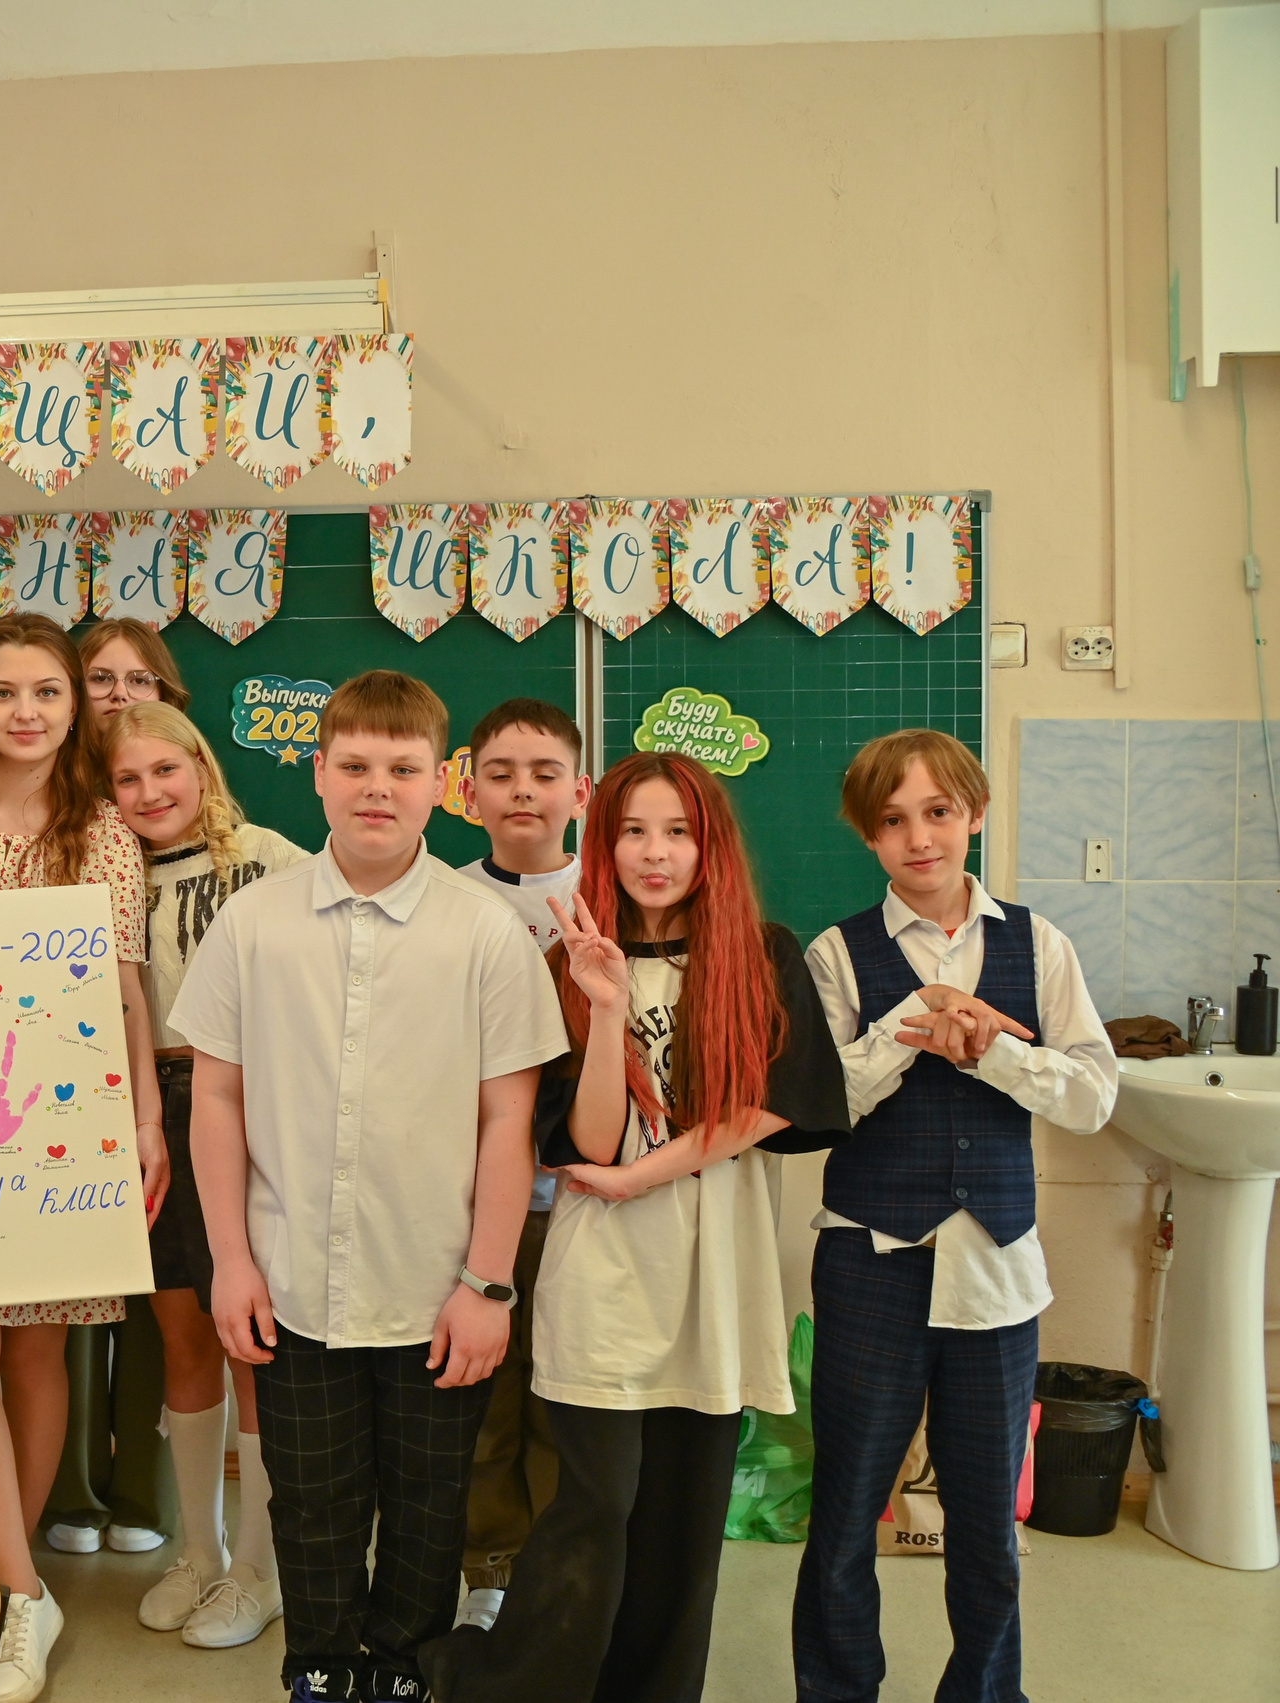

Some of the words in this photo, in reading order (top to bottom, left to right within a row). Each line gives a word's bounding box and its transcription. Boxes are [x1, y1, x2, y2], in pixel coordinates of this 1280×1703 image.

[386, 520, 915, 600] ШКОЛА!
[667, 695, 719, 724] Буду
[247, 706, 320, 743] 202
[652, 720, 736, 743] скучать
[680, 740, 740, 766] всем!
[39, 1180, 129, 1215] класс
[894, 1530, 943, 1546] ROS
